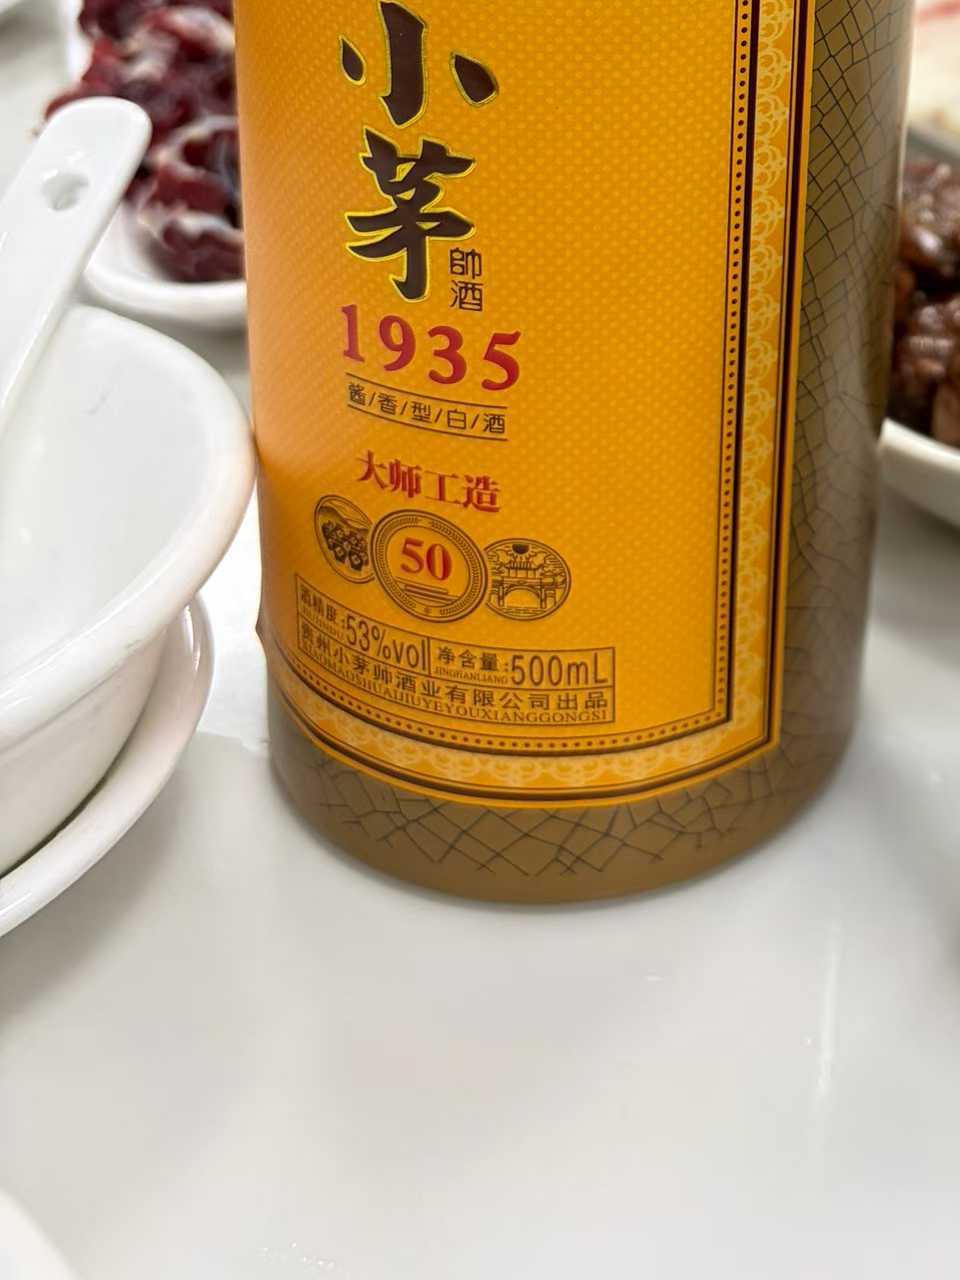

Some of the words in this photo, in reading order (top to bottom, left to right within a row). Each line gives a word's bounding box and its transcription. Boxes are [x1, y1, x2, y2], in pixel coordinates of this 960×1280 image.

[341, 304, 521, 391] 1935
[356, 448, 501, 513] 大师工造
[400, 536, 453, 581] 50
